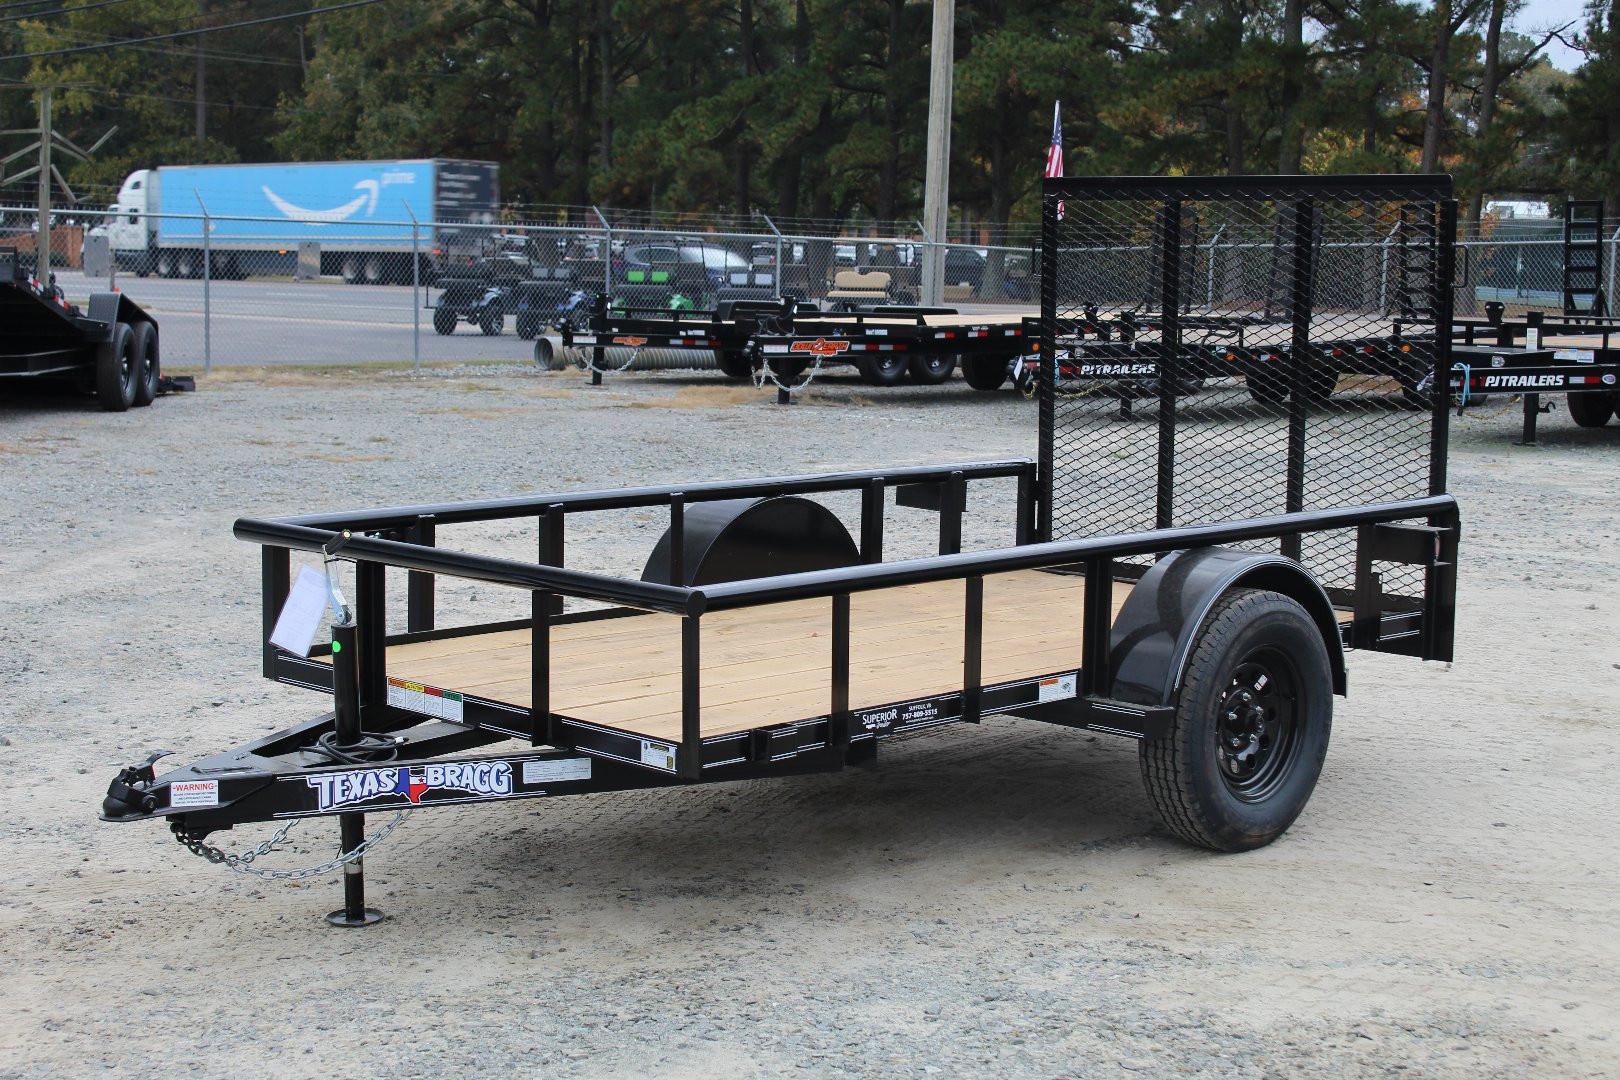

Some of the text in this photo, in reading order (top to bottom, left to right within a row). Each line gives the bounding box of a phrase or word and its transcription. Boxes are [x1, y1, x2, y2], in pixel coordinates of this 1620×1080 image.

[862, 708, 898, 725] SUPERIOR
[308, 769, 397, 811] TEXAS
[426, 762, 512, 795] BRAGG
